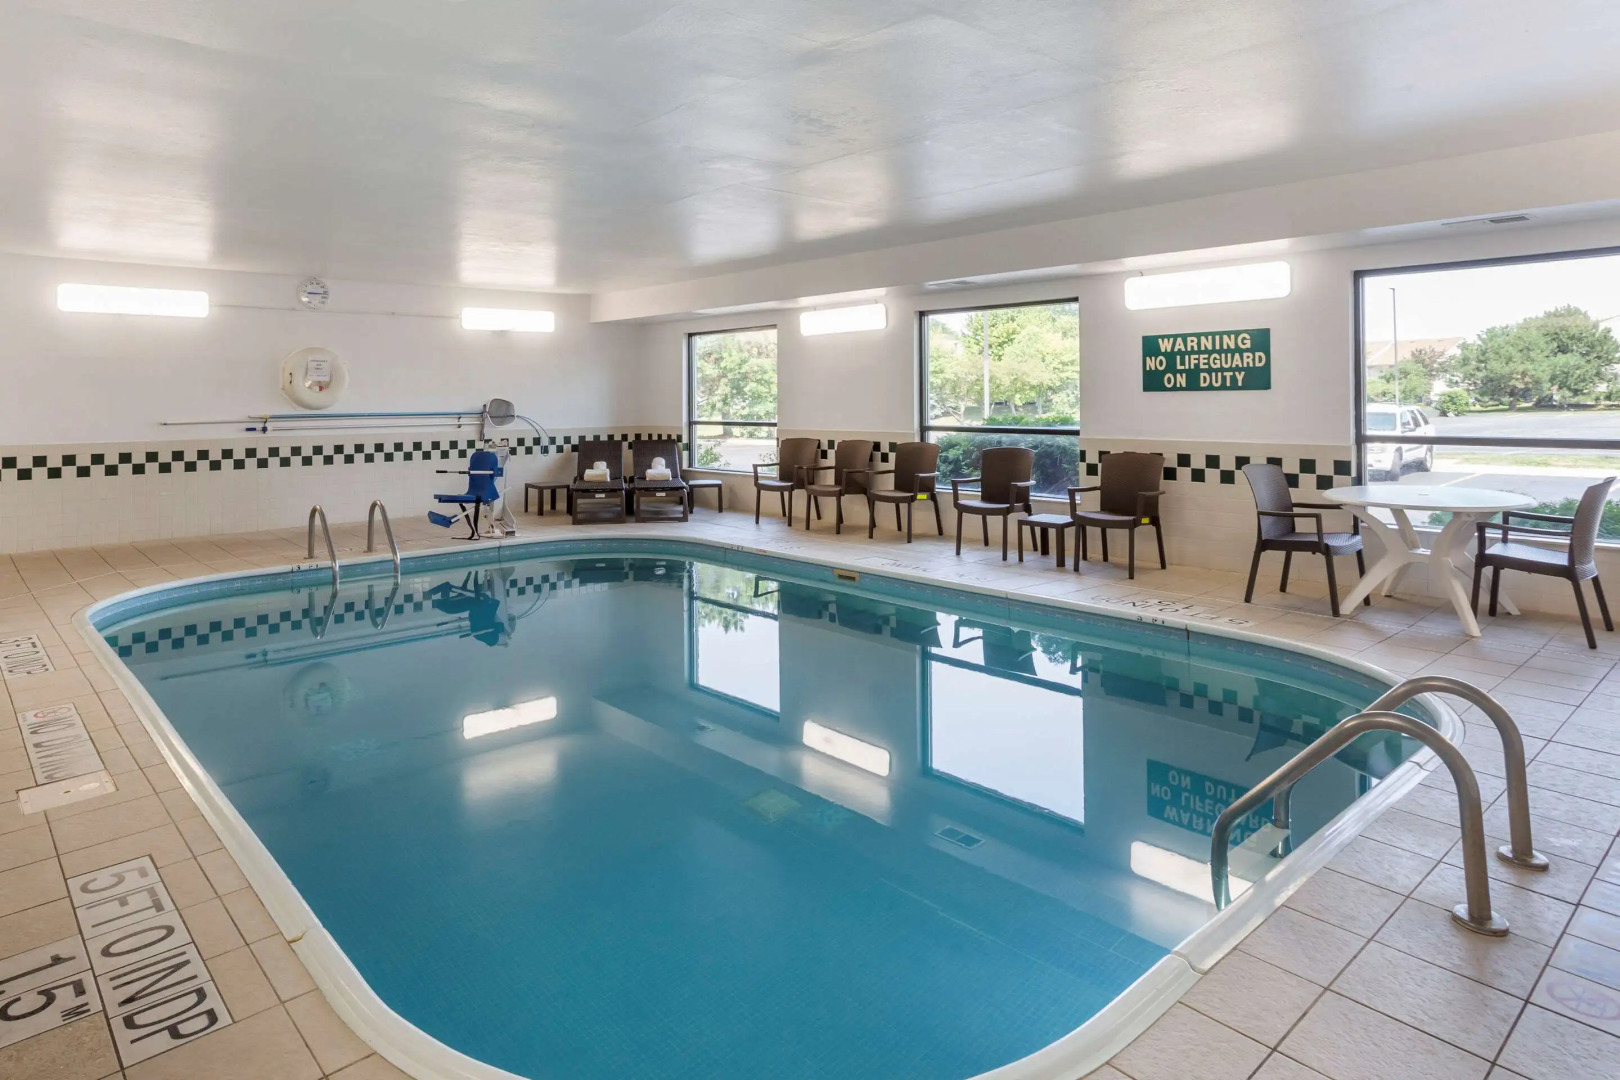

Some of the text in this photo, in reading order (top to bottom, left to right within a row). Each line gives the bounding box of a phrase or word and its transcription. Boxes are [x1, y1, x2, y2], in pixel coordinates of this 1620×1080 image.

[1158, 333, 1251, 352] WARNING
[1145, 351, 1266, 371] NO LIFEGUARD
[1163, 371, 1245, 388] ON DUTY
[27, 715, 77, 735] NO
